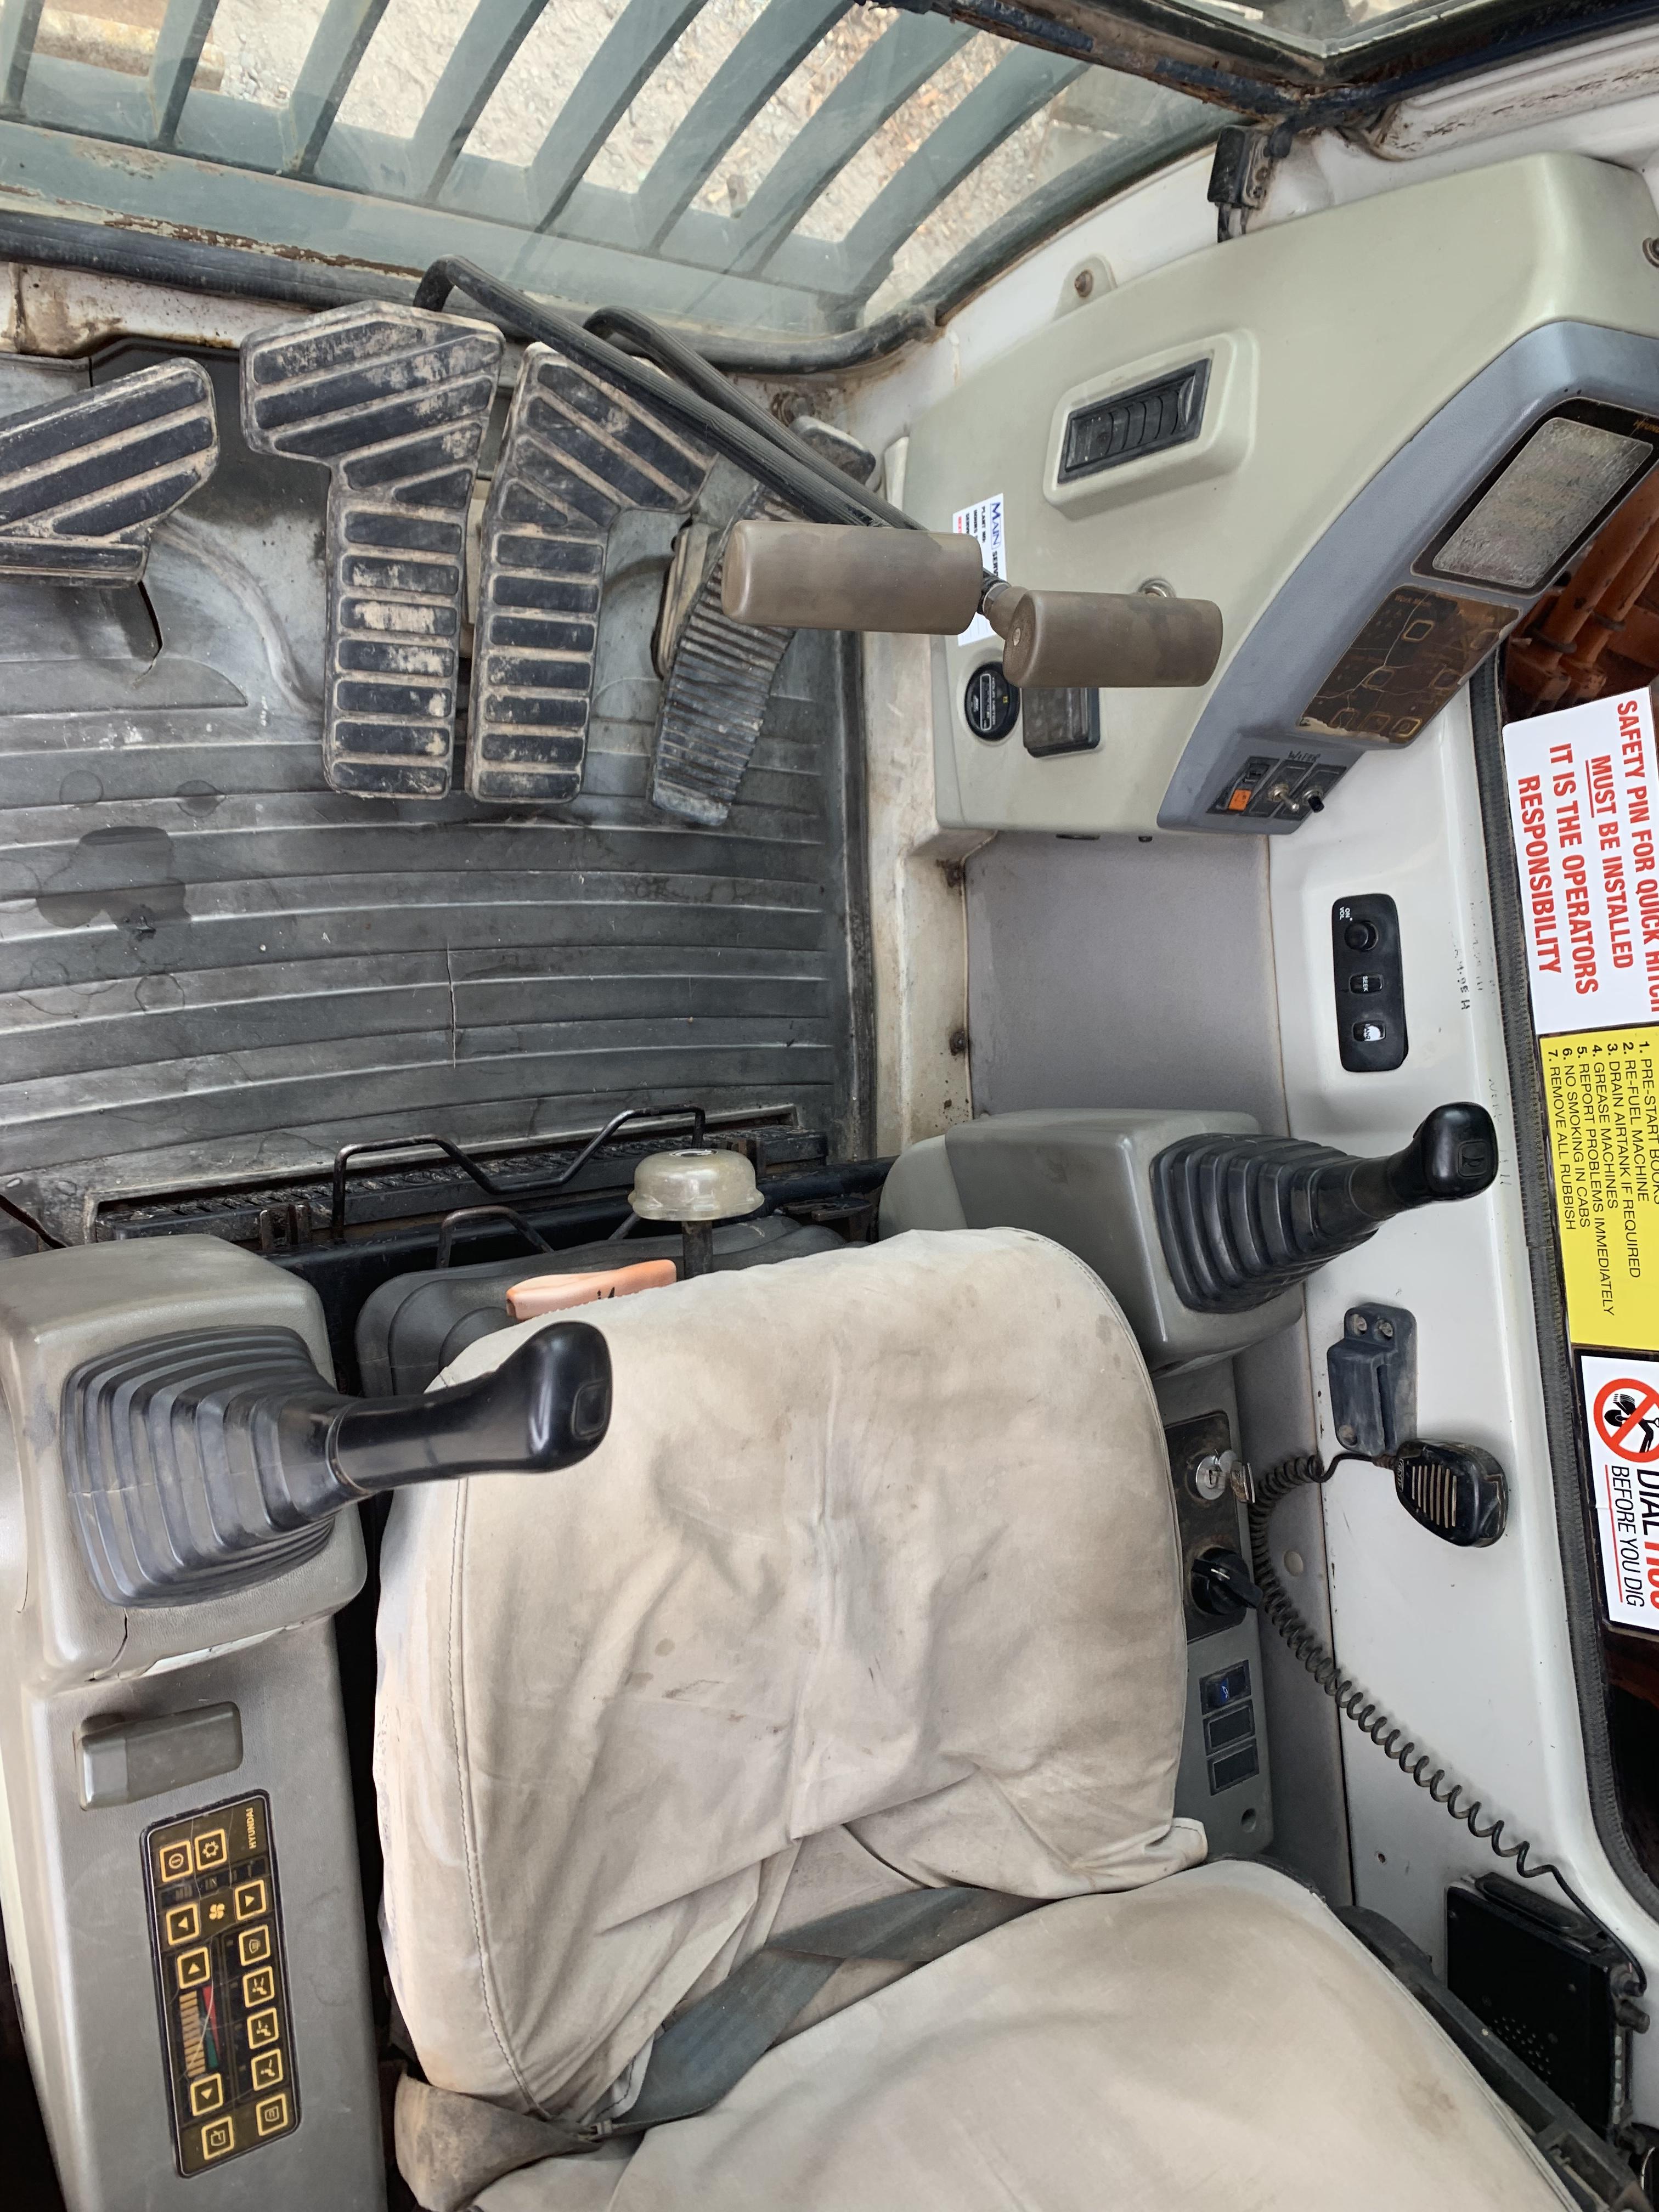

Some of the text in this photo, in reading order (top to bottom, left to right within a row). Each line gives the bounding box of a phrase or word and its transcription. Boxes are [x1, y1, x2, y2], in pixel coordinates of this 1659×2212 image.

[991, 502, 1001, 546] MAIN
[1617, 700, 1645, 778] SAFETY
[1627, 786, 1649, 823] PIN
[1632, 830, 1655, 872] FOR
[1345, 908, 1351, 918] ON
[1519, 775, 1561, 973] RESPONSIBILITY
[1550, 744, 1598, 994] IT IS THE OPERATORS
[1592, 755, 1633, 968] MUST BE INSTALLED
[1636, 879, 1659, 944] QUICK
[1639, 1041, 1650, 1053] 1.
[1641, 1059, 1659, 1144] PRE-START
[1548, 1049, 1576, 1229] 7. REMOVE ALL RUBBISH
[1562, 1048, 1590, 1227] 6. NO SMOKING IN CABS
[1592, 1045, 1618, 1209] 4. GREASE MACHINES
[1607, 1043, 1640, 1278] 3. DRAIN AIRTANK IF REQUIRED
[1623, 1042, 1649, 1201] 2. RE-FUEL MACHINE
[1577, 1047, 1614, 1316] 5. REPORT PROBLEMS IMMEDIATELY
[1611, 1466, 1644, 1607] BEFORE YOU DIG
[1637, 1469, 1659, 1536] DIAL
[245, 1808, 256, 1849] HYUNDAI
